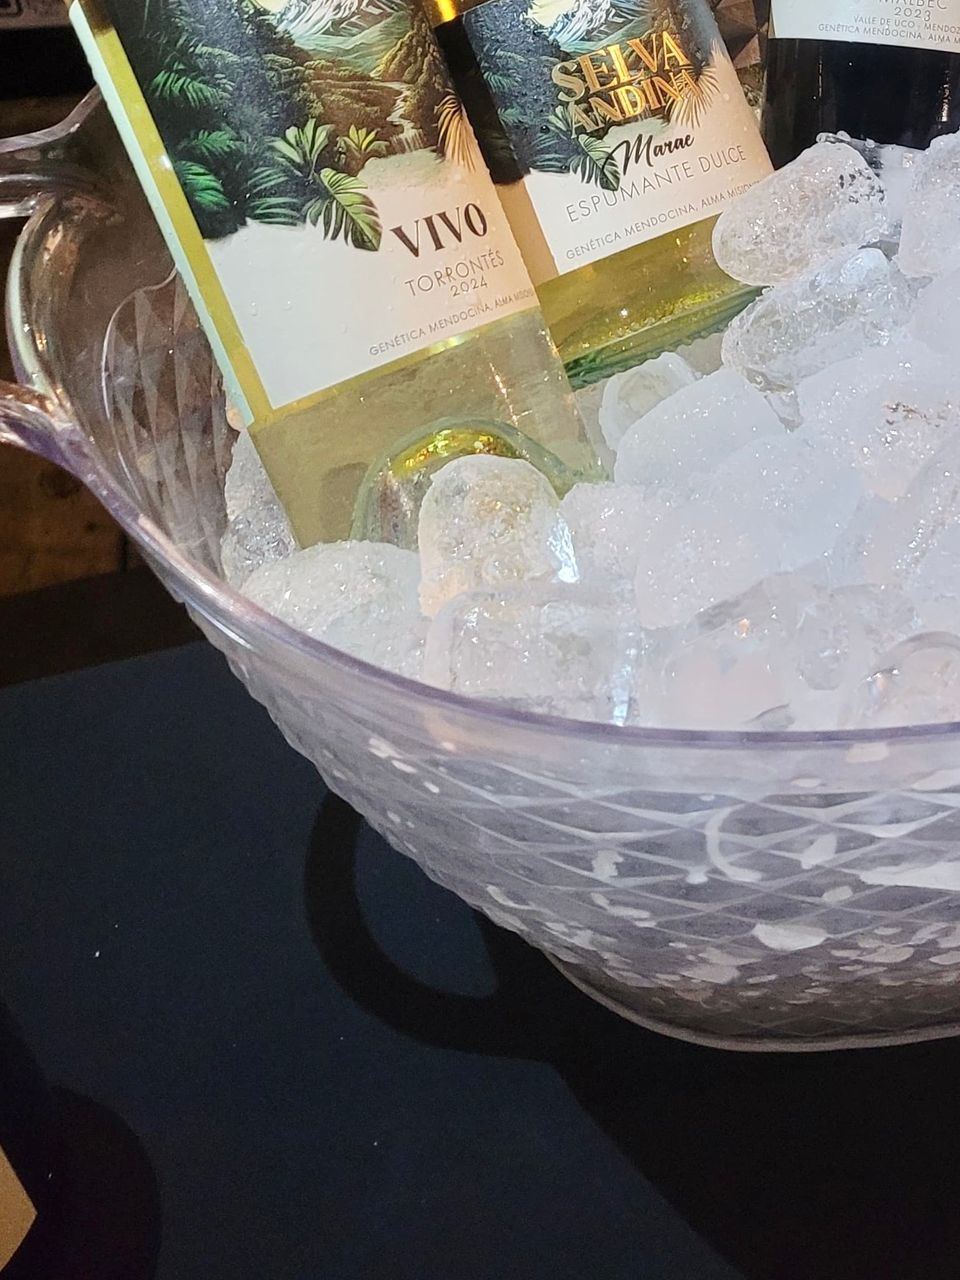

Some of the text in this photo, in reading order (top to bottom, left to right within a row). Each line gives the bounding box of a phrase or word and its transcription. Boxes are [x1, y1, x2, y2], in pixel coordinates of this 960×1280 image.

[818, 23, 860, 33] GENÉTICA
[928, 33, 950, 43] ALMA
[853, 15, 878, 25] VALLE
[880, 17, 891, 26] DE
[895, 19, 915, 28] UCO
[894, 7, 931, 22] 2023
[551, 31, 690, 102] SELVA
[571, 68, 702, 138] ANDINA
[602, 133, 695, 176] Marae
[566, 145, 746, 223] ESPUMANTE DULCE
[390, 203, 488, 258] VIVO
[566, 230, 621, 260] GENÉTICA
[701, 192, 726, 208] ALMA
[404, 248, 505, 297] TORRONTÉS
[450, 276, 488, 297] 2024
[369, 327, 426, 356] GENÉTICA
[495, 294, 514, 309] ALMA
